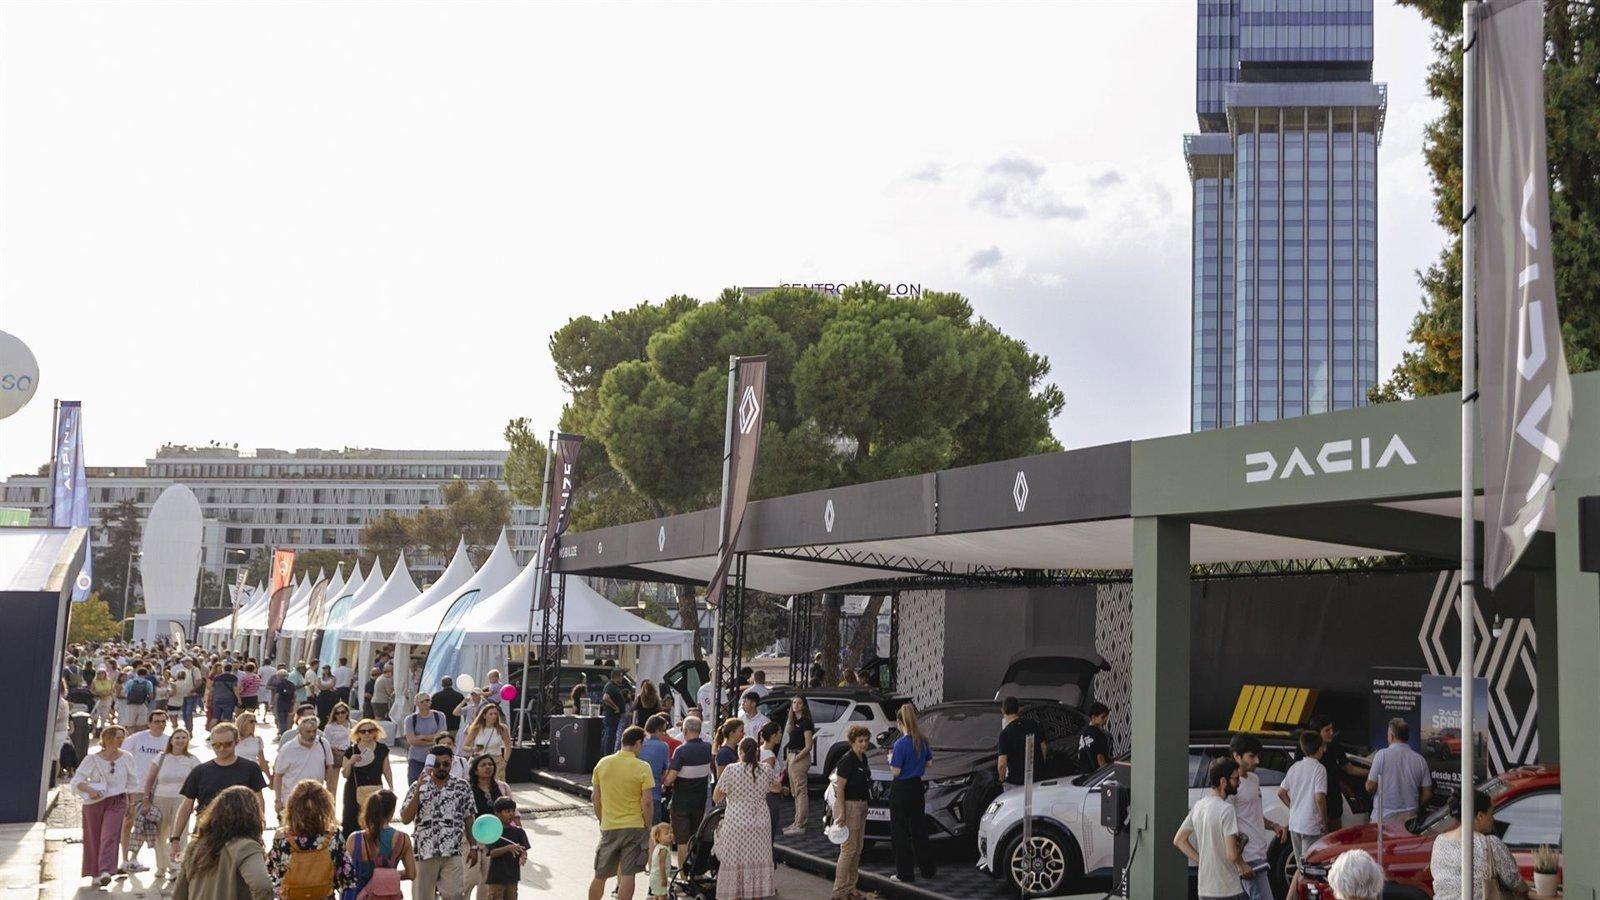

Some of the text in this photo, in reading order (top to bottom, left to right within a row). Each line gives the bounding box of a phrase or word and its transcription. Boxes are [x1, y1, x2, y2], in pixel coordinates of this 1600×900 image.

[63, 418, 72, 491] ALPINE
[1245, 433, 1418, 484] DACIA
[584, 633, 651, 644] JAECOO
